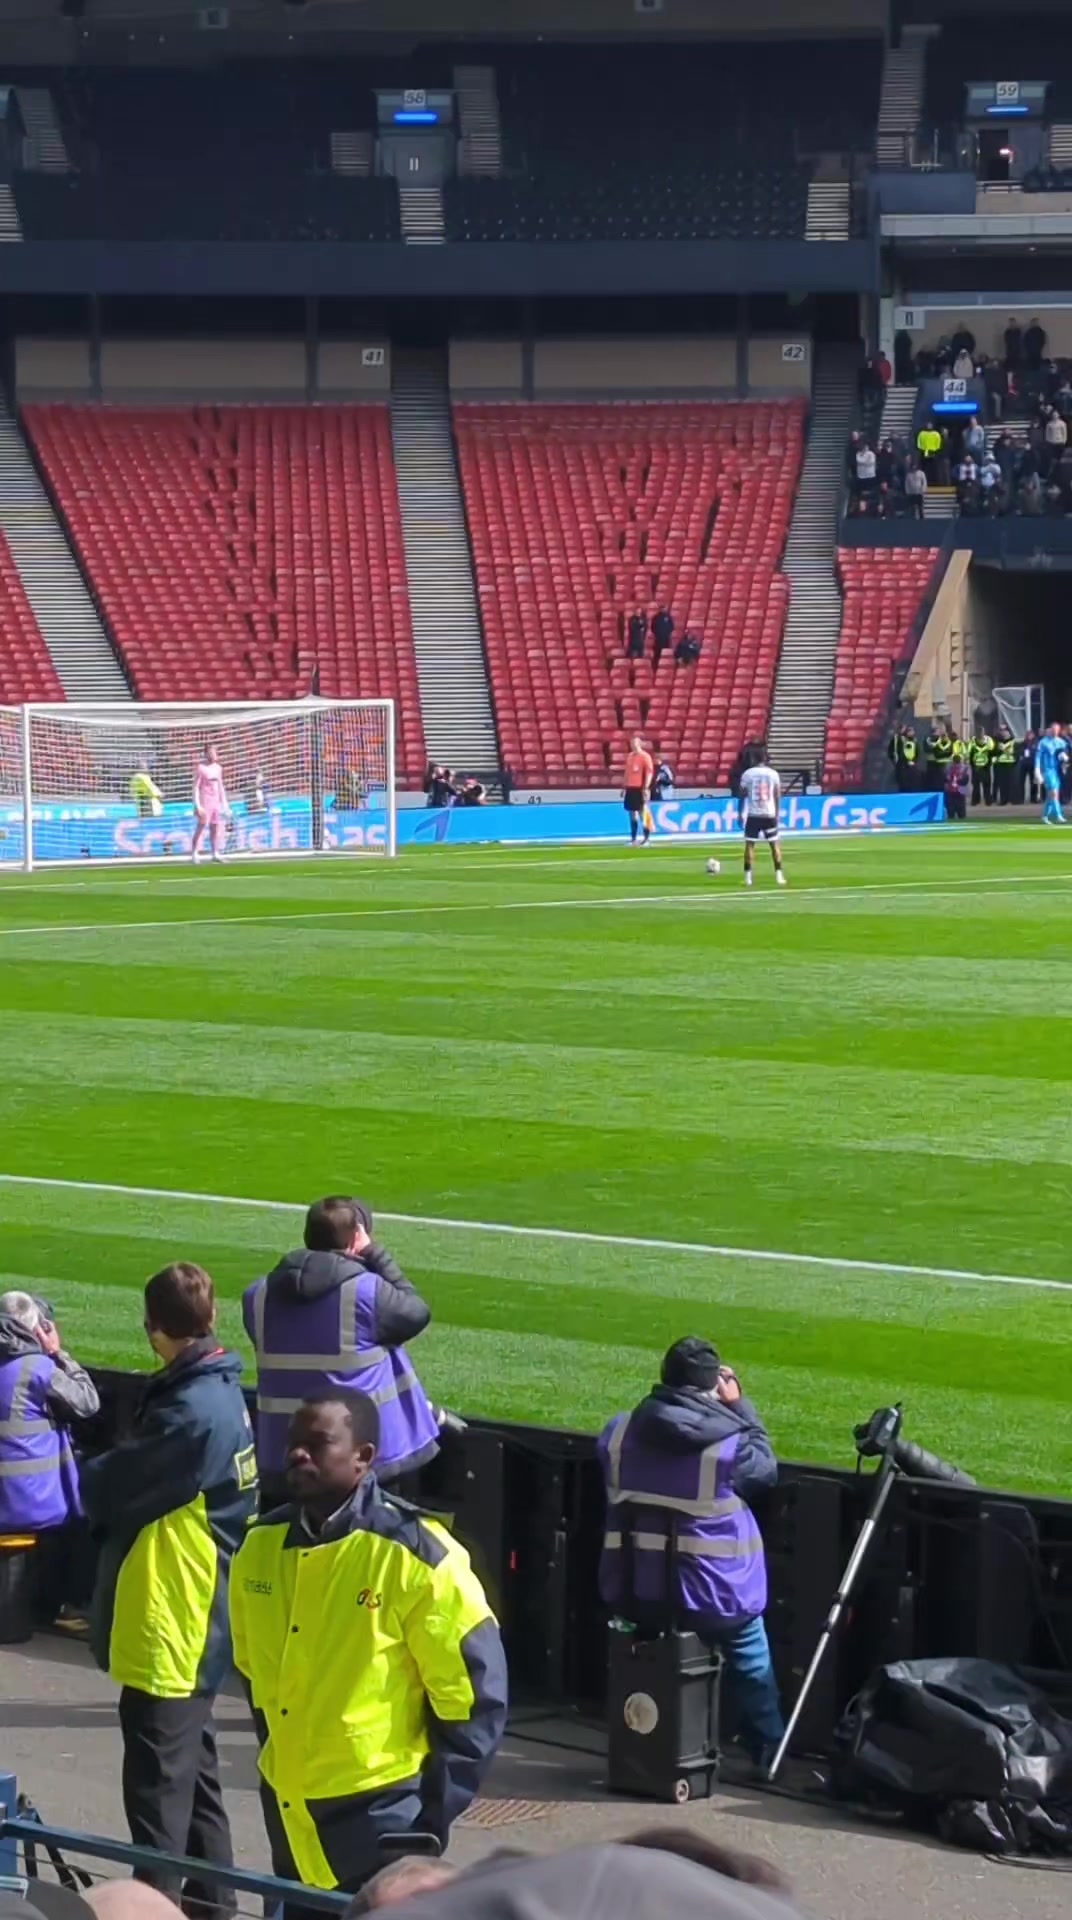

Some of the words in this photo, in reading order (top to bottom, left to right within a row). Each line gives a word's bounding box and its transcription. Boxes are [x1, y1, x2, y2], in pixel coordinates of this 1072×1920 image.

[998, 83, 1017, 97] 59
[365, 351, 382, 362] 41
[783, 346, 803, 359] 42
[945, 381, 965, 393] 44
[821, 795, 888, 830] Gas
